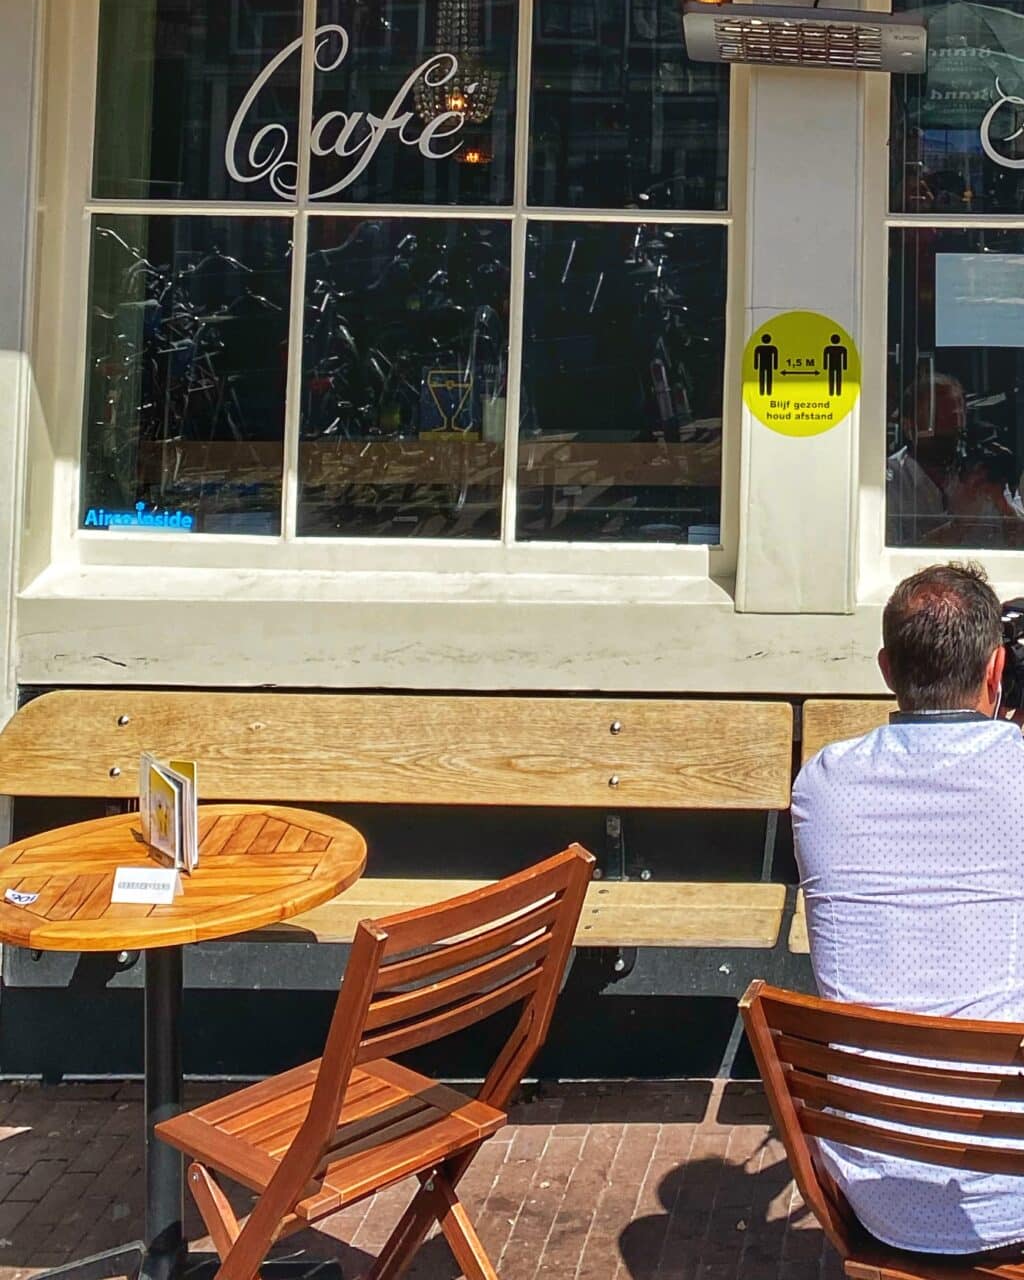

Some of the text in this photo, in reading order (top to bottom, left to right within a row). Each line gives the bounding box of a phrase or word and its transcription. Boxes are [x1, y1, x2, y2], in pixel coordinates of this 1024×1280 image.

[225, 24, 478, 201] Café
[785, 358, 815, 368] 1,5 M
[769, 400, 831, 410] Blijf gezond
[766, 412, 833, 420] houd afstand
